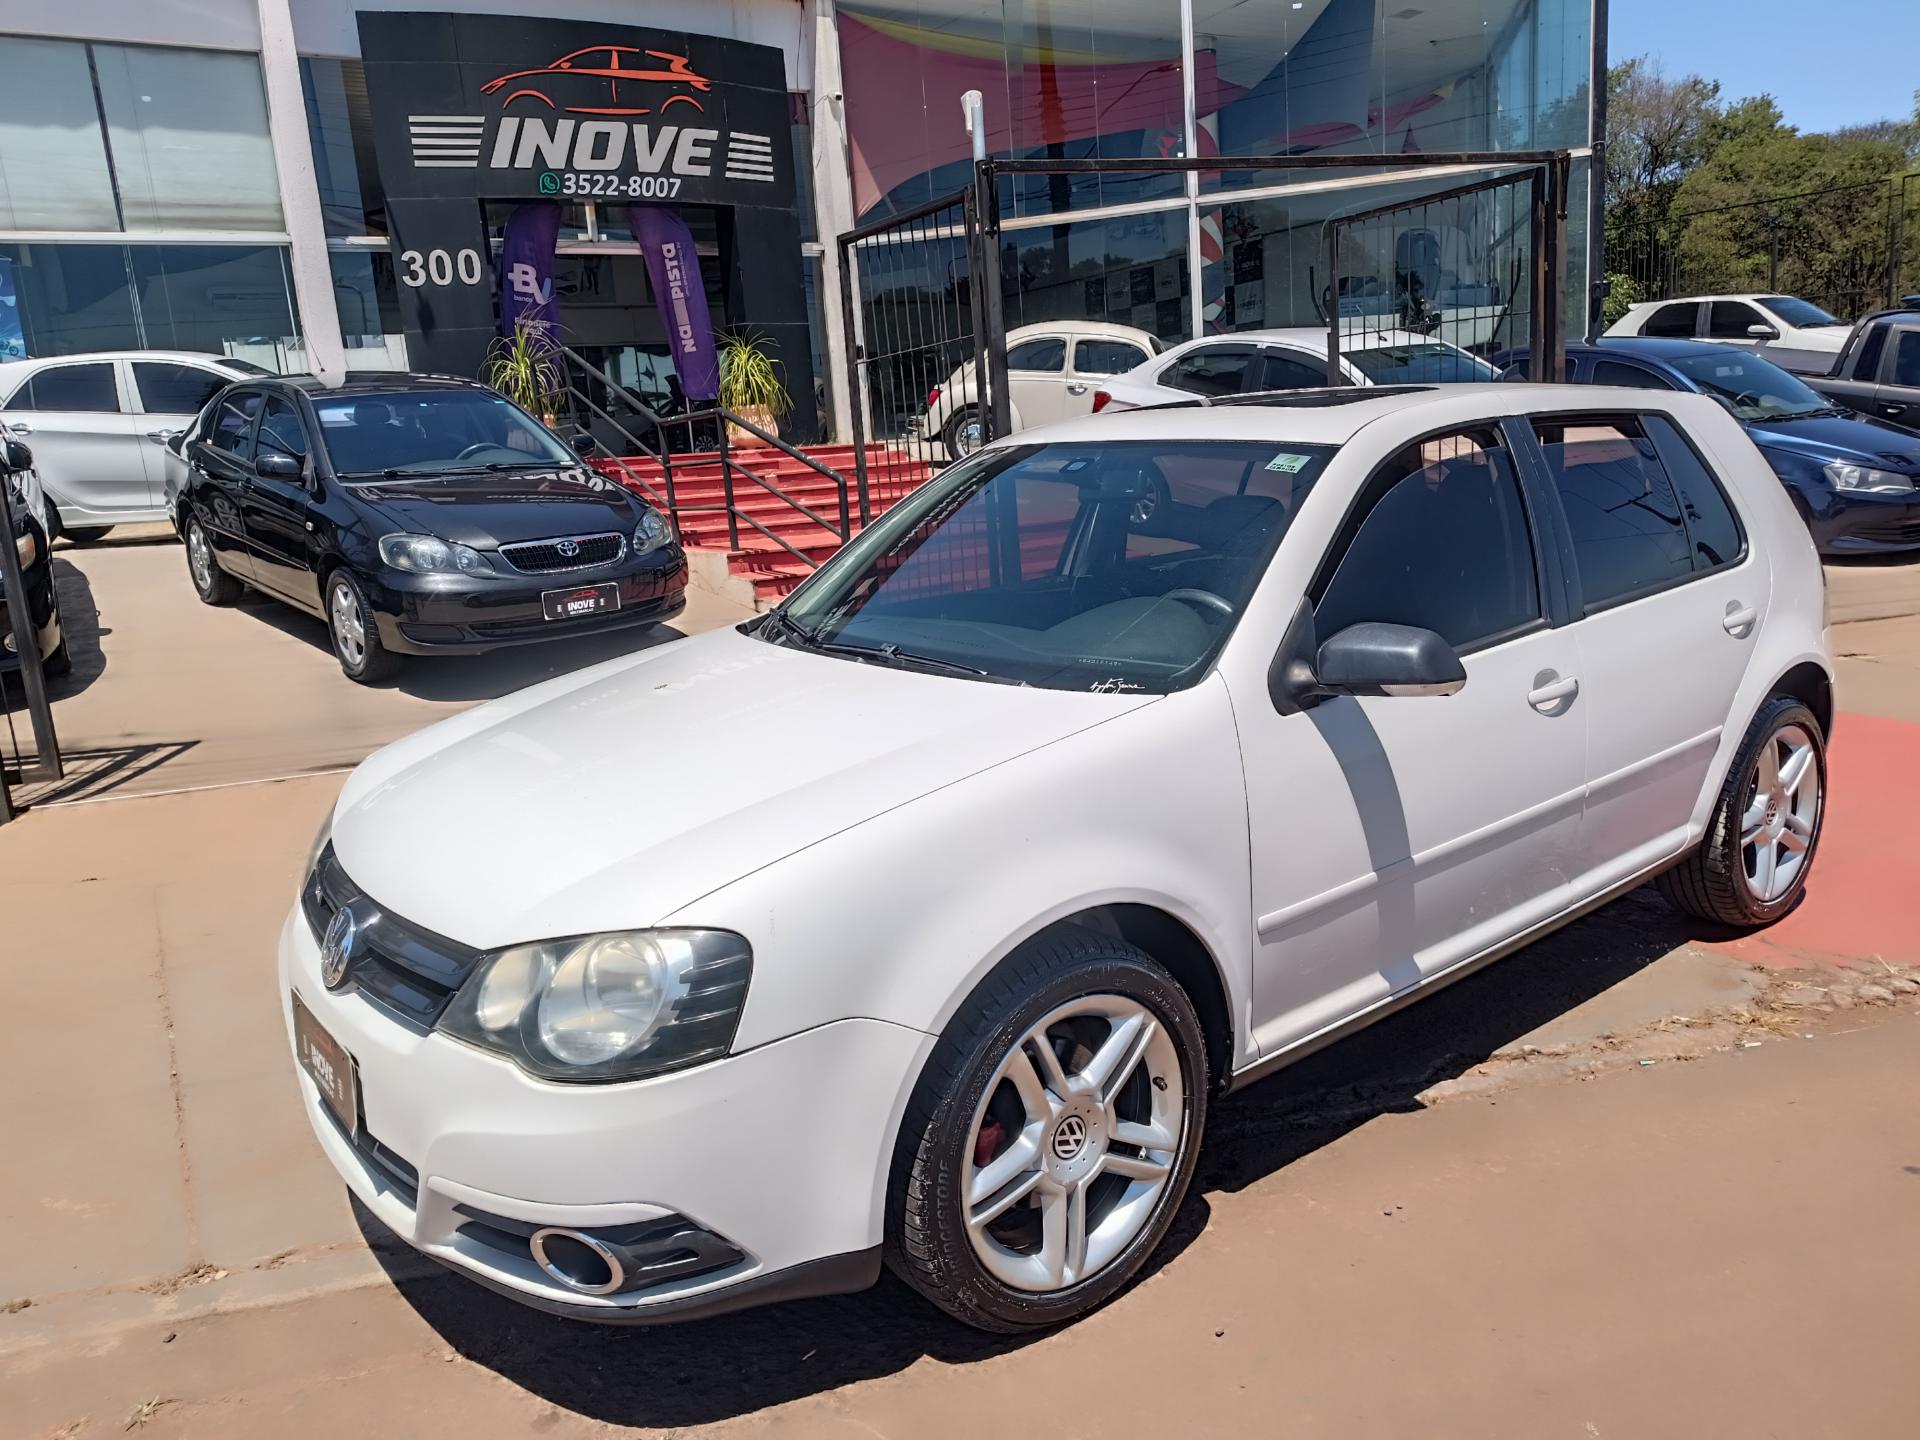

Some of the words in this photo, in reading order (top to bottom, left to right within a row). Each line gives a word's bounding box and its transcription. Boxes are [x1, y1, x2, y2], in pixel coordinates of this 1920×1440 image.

[490, 117, 719, 176] INOVE
[563, 173, 682, 199] 3522-8007
[401, 248, 482, 288] 300
[567, 599, 595, 611] INOVE
